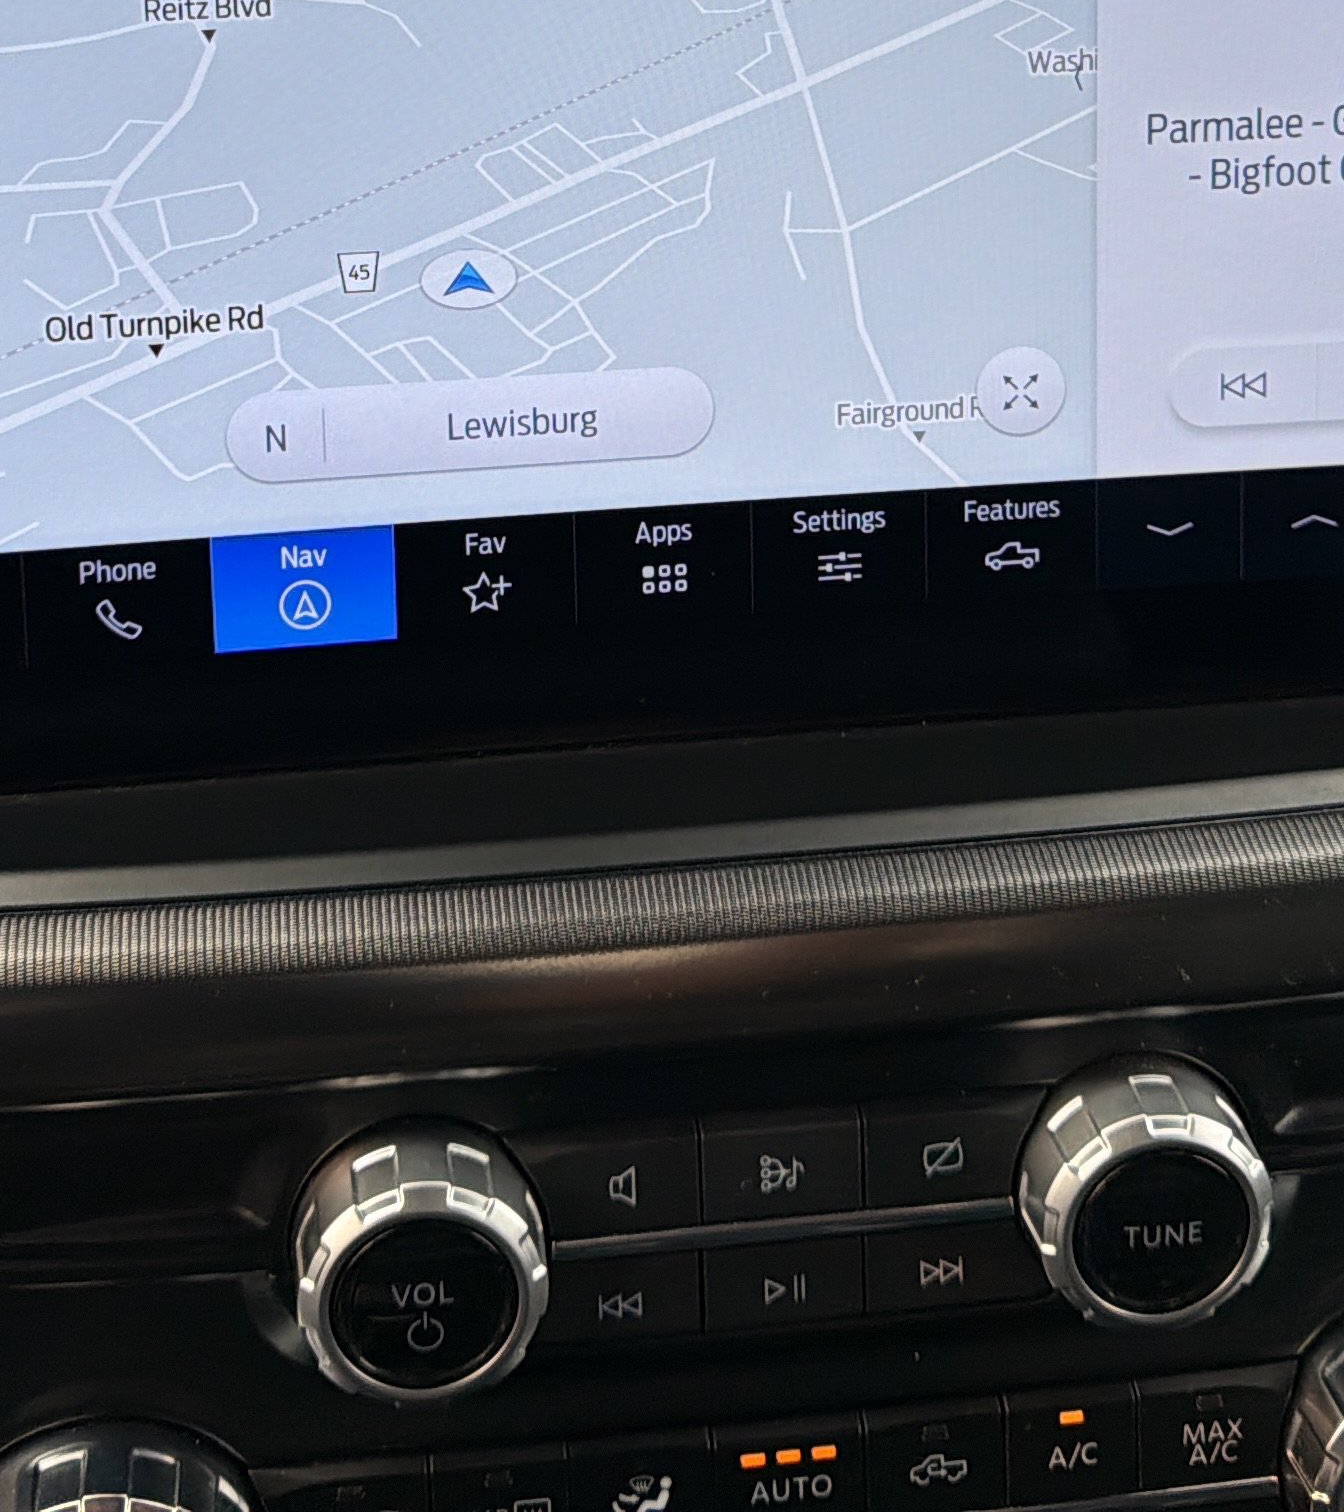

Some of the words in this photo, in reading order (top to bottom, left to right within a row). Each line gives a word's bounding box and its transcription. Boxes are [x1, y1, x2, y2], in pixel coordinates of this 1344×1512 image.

[1147, 107, 1303, 145] Parmalee
[1211, 155, 1332, 195] Bigfoot
[348, 263, 370, 281] 45
[45, 314, 94, 343] Old
[99, 309, 221, 342] Turnpike
[228, 303, 264, 331] Rd
[448, 406, 598, 441] Lewisburg
[837, 396, 964, 428] Fairground
[265, 423, 287, 453] N
[792, 508, 886, 534] Settings
[964, 499, 1061, 523] Features
[465, 532, 507, 556] Fav
[635, 521, 693, 547] Apps
[280, 545, 327, 570] Nav
[79, 559, 157, 585] Phone
[1123, 1220, 1202, 1248] TUNE
[391, 1280, 454, 1308] VOL
[1182, 1418, 1242, 1445] MAX
[1048, 1441, 1098, 1470] A/C
[1188, 1440, 1240, 1466] A/C
[750, 1474, 833, 1505] AUTO
